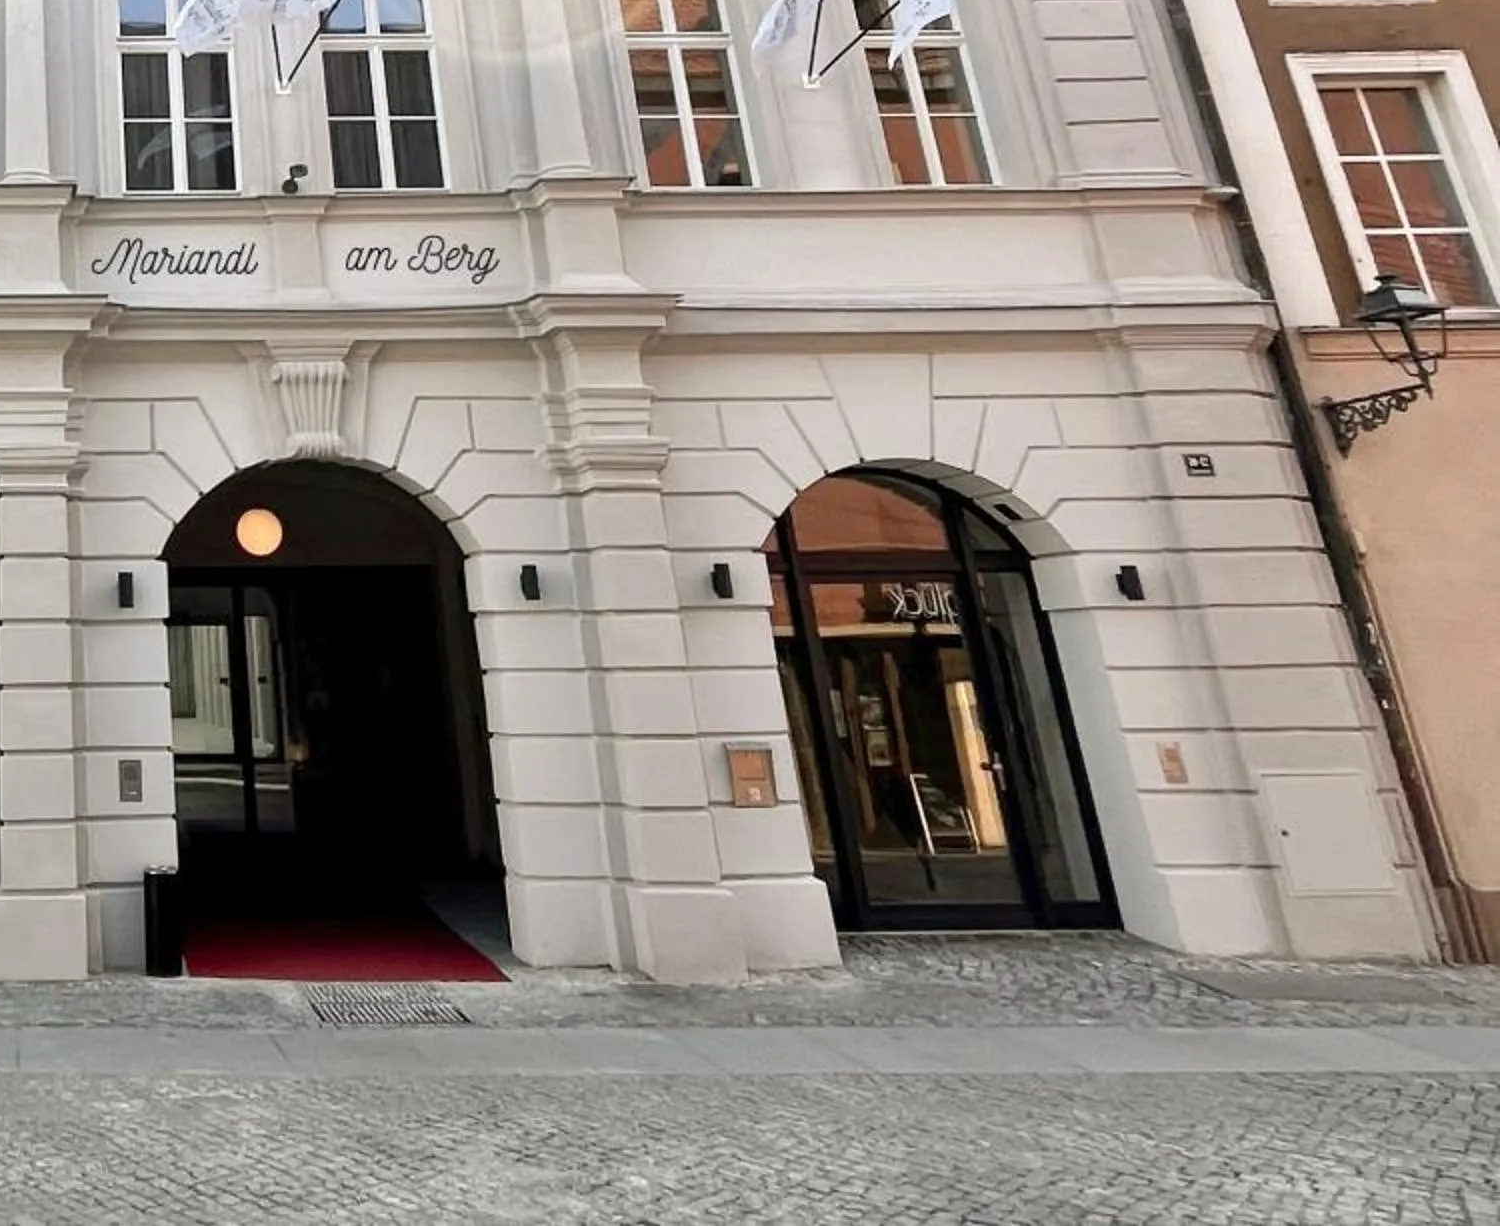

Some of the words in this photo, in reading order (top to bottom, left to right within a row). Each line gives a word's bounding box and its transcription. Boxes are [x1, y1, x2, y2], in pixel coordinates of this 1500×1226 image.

[91, 237, 259, 285] Mariandl
[345, 247, 398, 271] am
[407, 234, 501, 285] Berg
